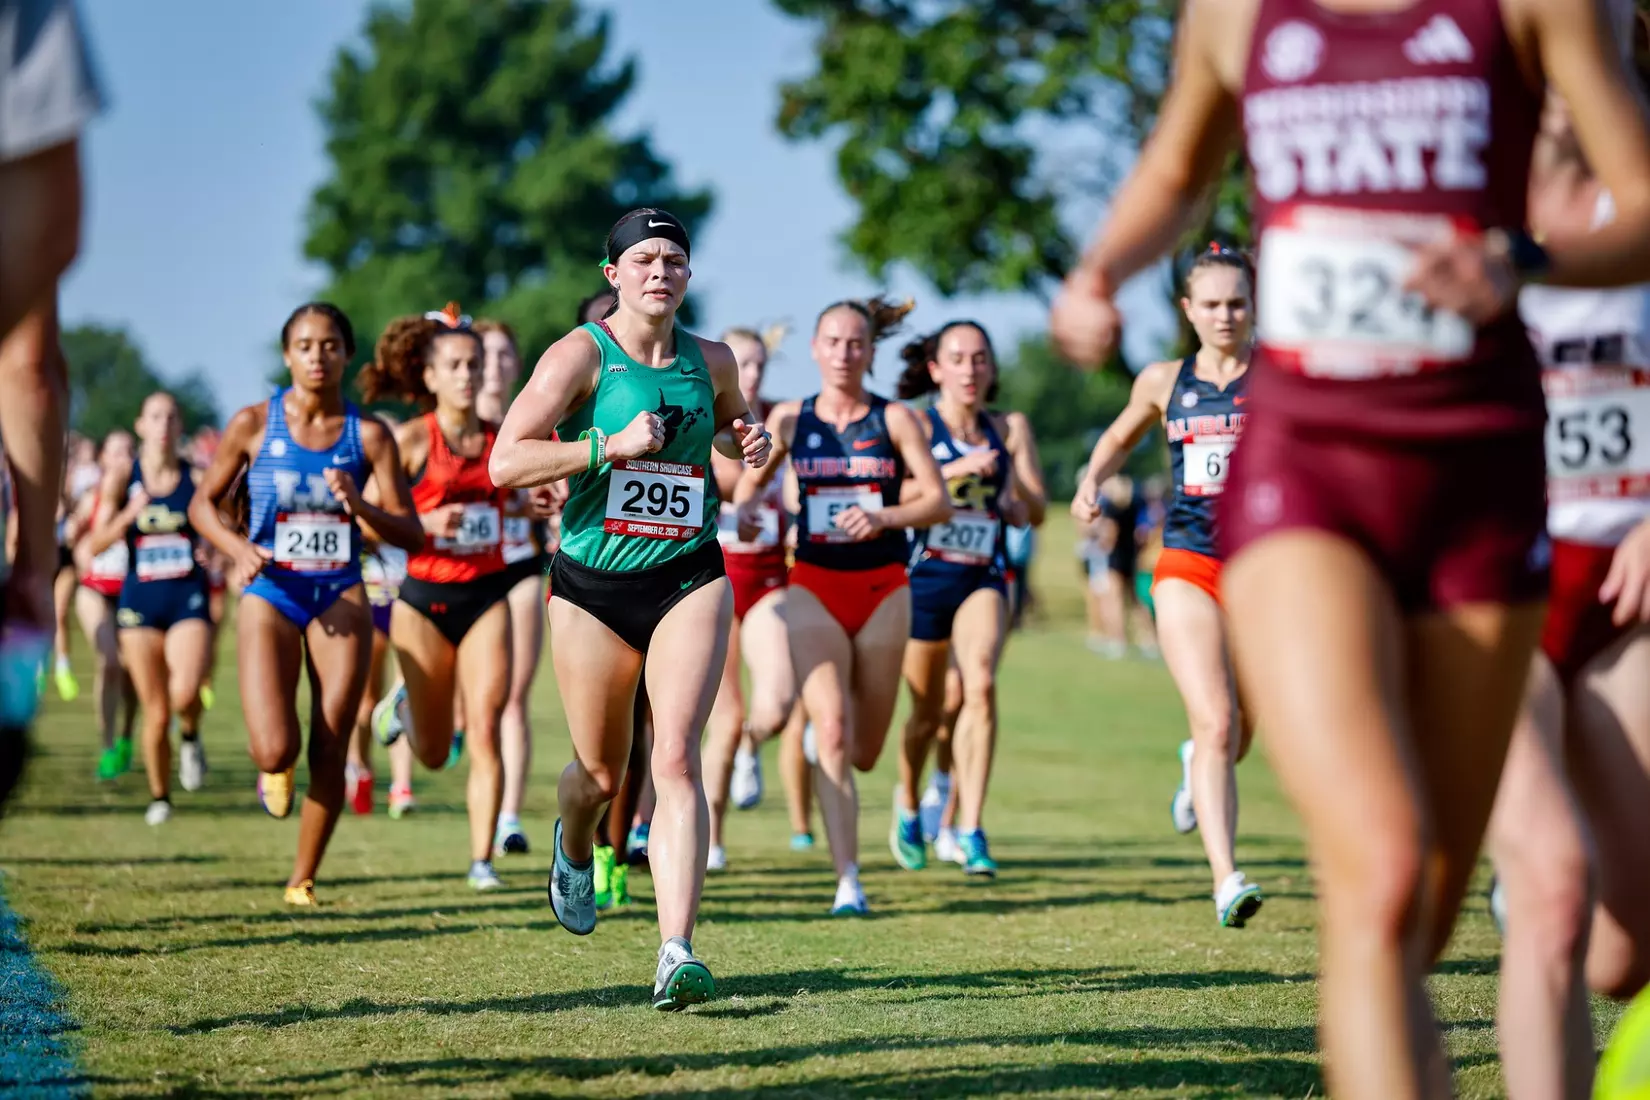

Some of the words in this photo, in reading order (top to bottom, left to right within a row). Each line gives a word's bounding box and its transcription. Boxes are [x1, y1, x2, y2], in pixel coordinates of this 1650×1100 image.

[1249, 118, 1488, 202] STATE
[1558, 407, 1631, 470] 53
[626, 460, 659, 473] SOUTHERN
[660, 463, 693, 476] SHOWCASE
[793, 456, 896, 478] AUBURN
[621, 480, 691, 518] 295
[288, 530, 338, 554] 248
[627, 523, 658, 535] SEPTEMBER
[665, 528, 679, 537] 2025
[941, 523, 987, 550] 207
